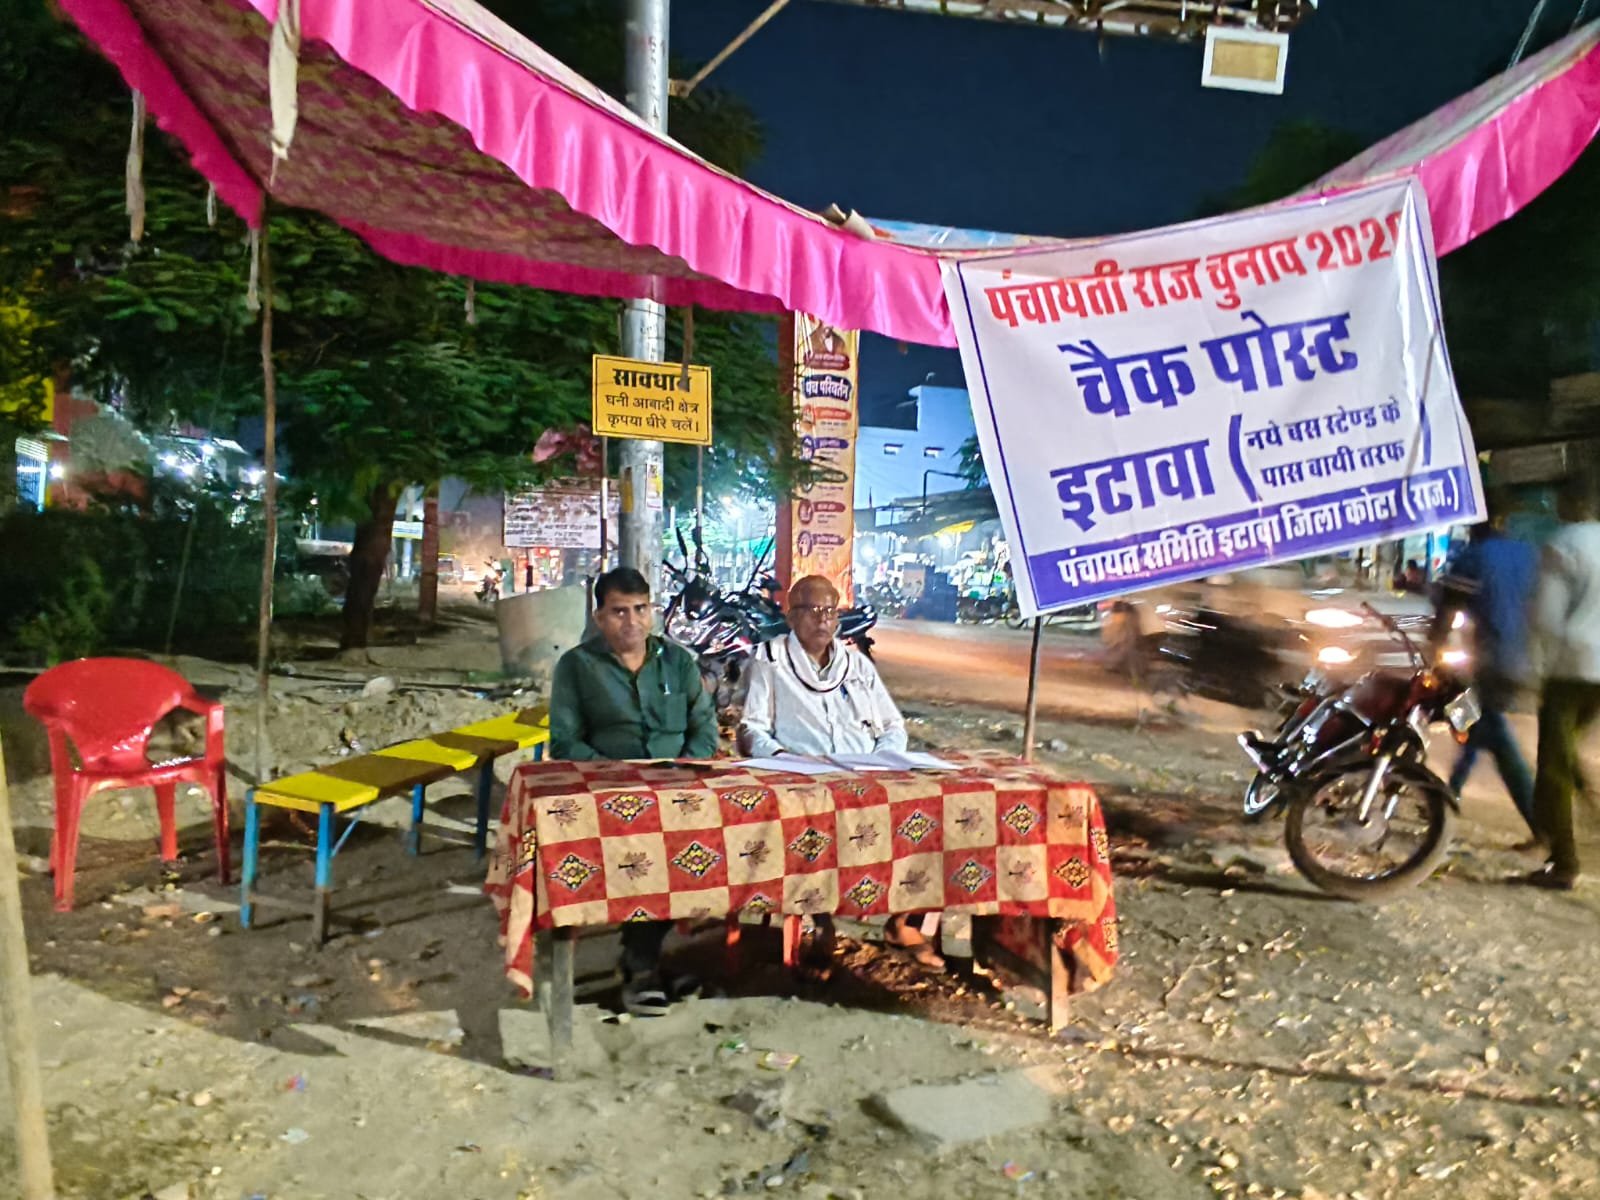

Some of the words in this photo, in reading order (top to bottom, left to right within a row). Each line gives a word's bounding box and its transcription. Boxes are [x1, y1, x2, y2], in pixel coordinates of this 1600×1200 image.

[984, 259, 1128, 328] पंचायती
[1129, 258, 1202, 308] राज
[1206, 235, 1307, 311] चुनाव
[605, 392, 629, 408] घनी
[1057, 340, 1196, 417] चैक
[1199, 311, 1358, 392] पोस्ट
[607, 413, 642, 429] कृपया
[1244, 420, 1283, 450] नये
[1285, 416, 1322, 442] बस
[1379, 396, 1401, 424] के
[1050, 439, 1216, 532] इटावा
[1260, 461, 1304, 487] पास
[1357, 439, 1405, 469] तरफ
[1056, 548, 1141, 588] पंचायत
[1139, 523, 1216, 570] समिति
[1215, 513, 1282, 558] इटावा
[1280, 503, 1343, 541] जिला
[1342, 487, 1399, 526] कोटा
[1402, 469, 1460, 521] (राज.)
